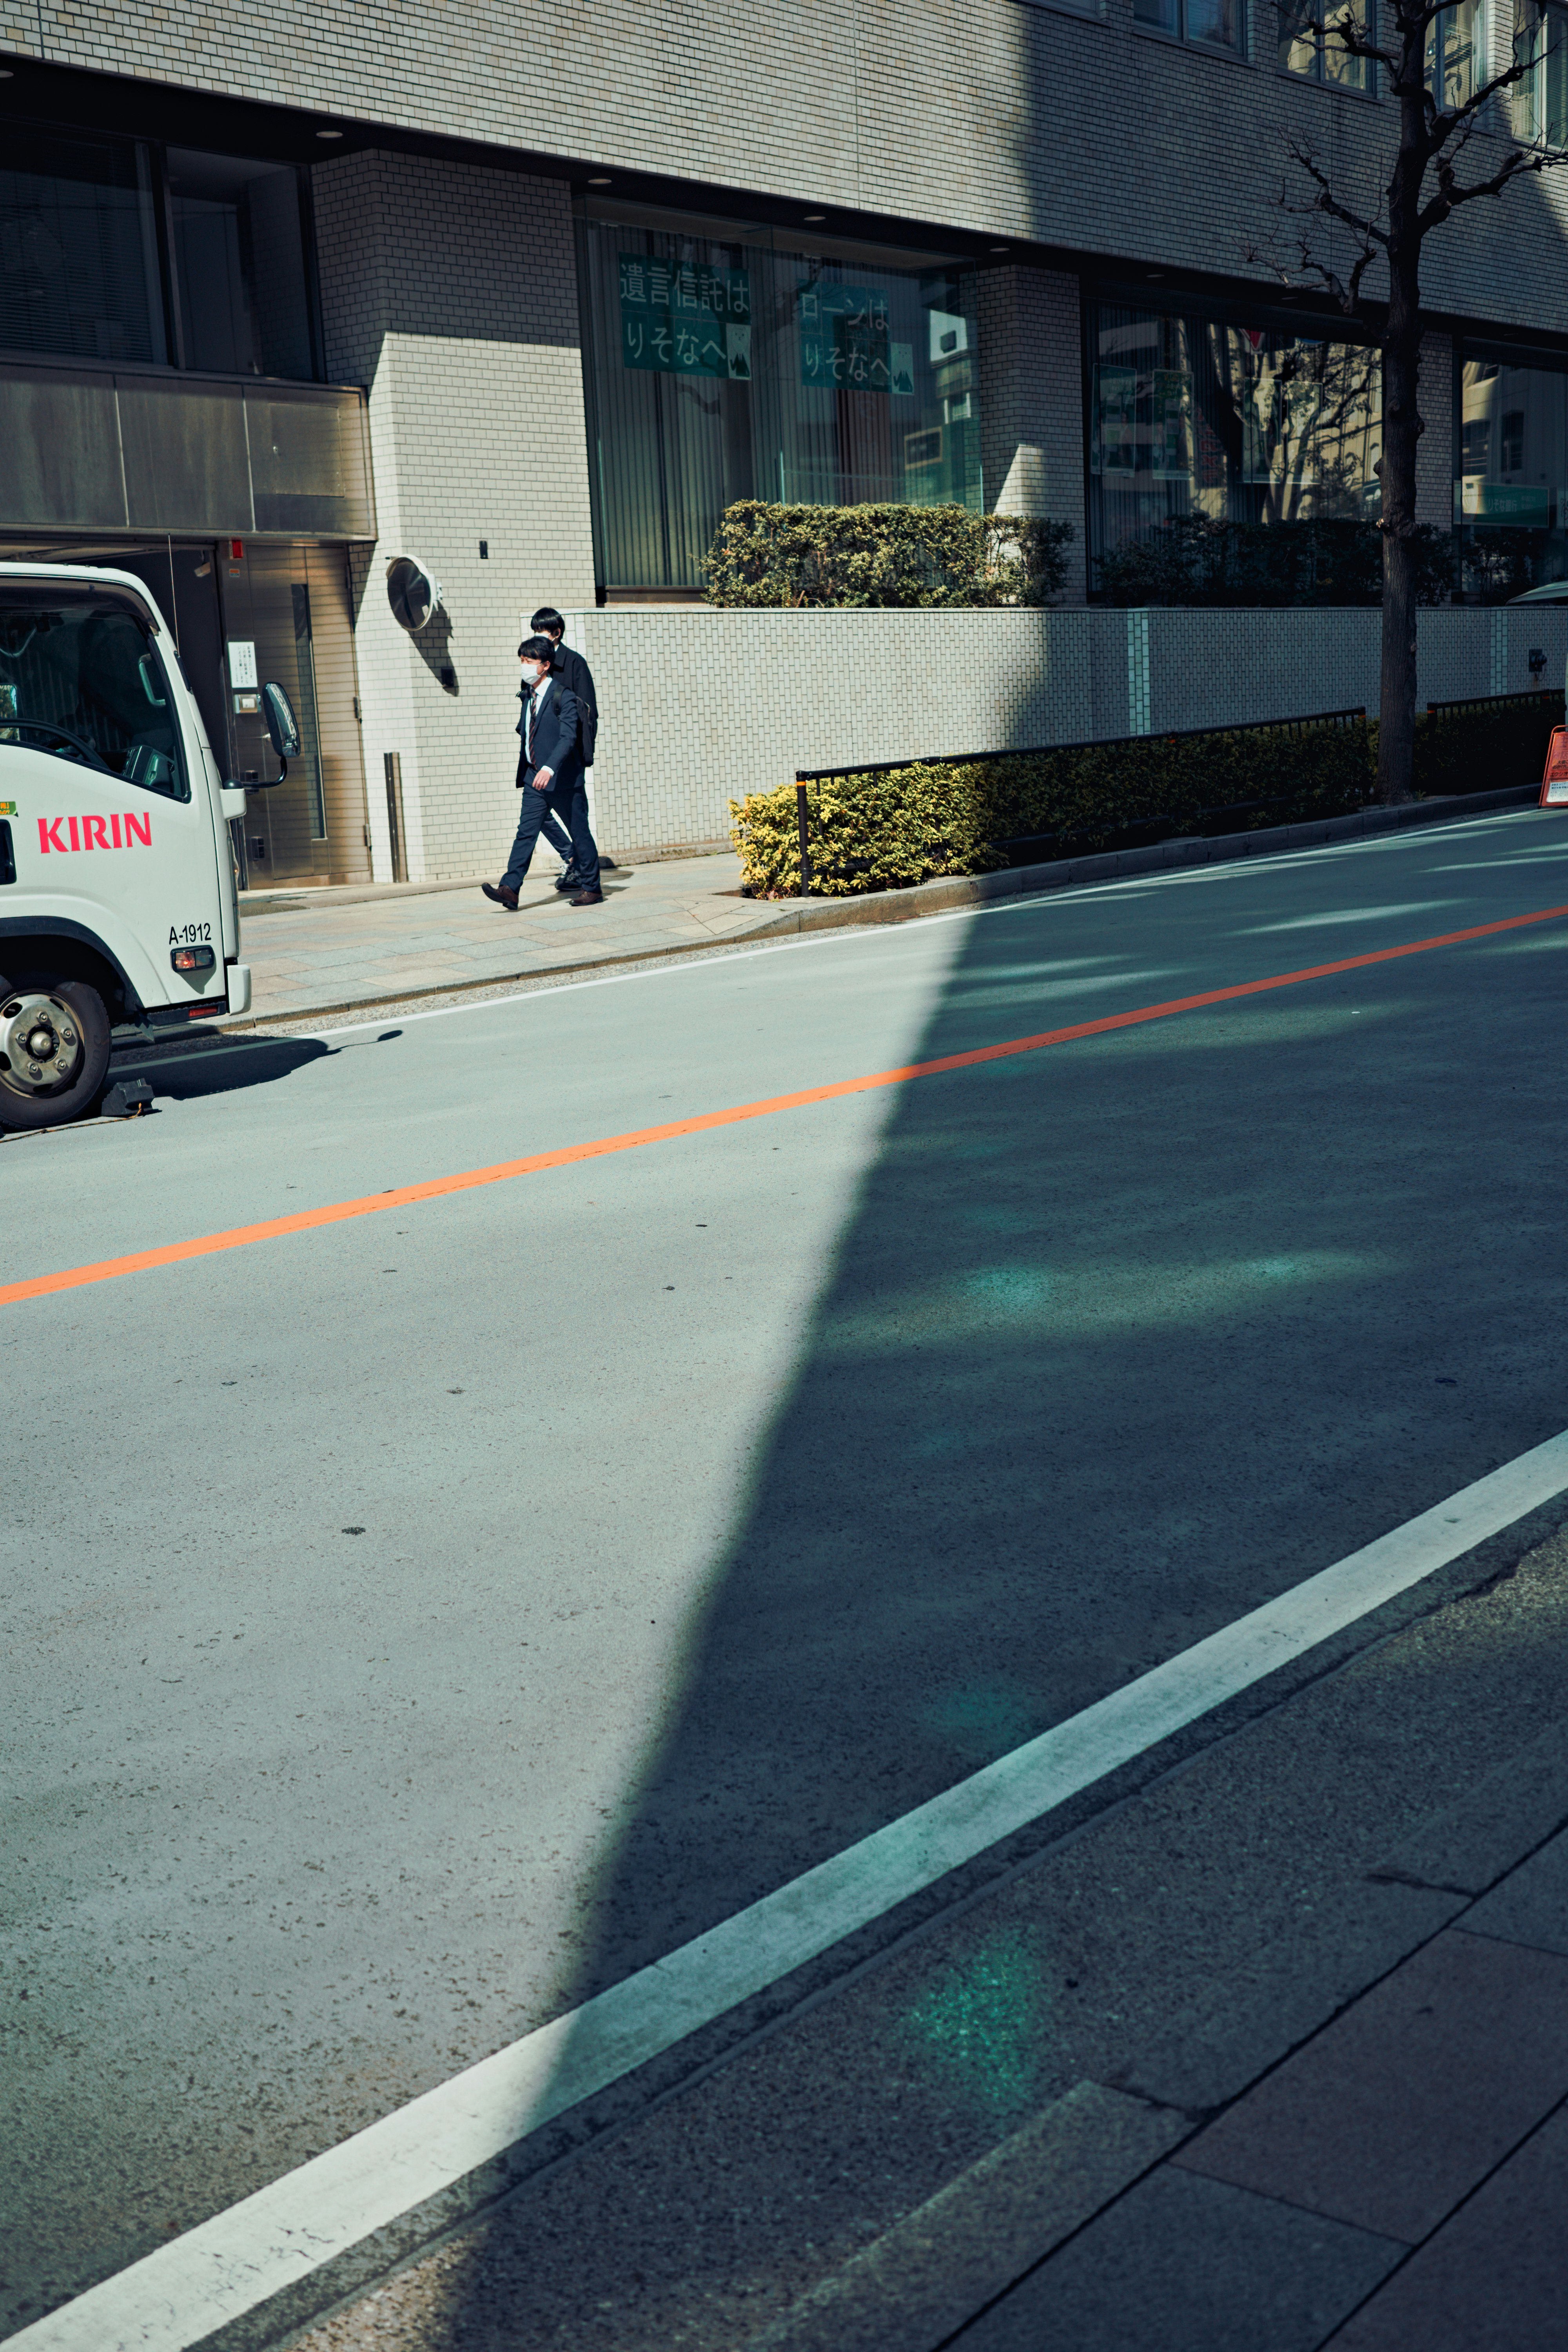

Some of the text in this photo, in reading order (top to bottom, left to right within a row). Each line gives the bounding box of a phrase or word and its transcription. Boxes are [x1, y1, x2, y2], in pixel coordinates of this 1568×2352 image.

[620, 262, 750, 313] 遺言信託は
[801, 292, 890, 331] ローンは
[628, 322, 727, 365] りそなへ
[806, 343, 891, 382] りそなへ
[37, 812, 152, 854] KIRIN
[169, 923, 212, 945] A-1912
